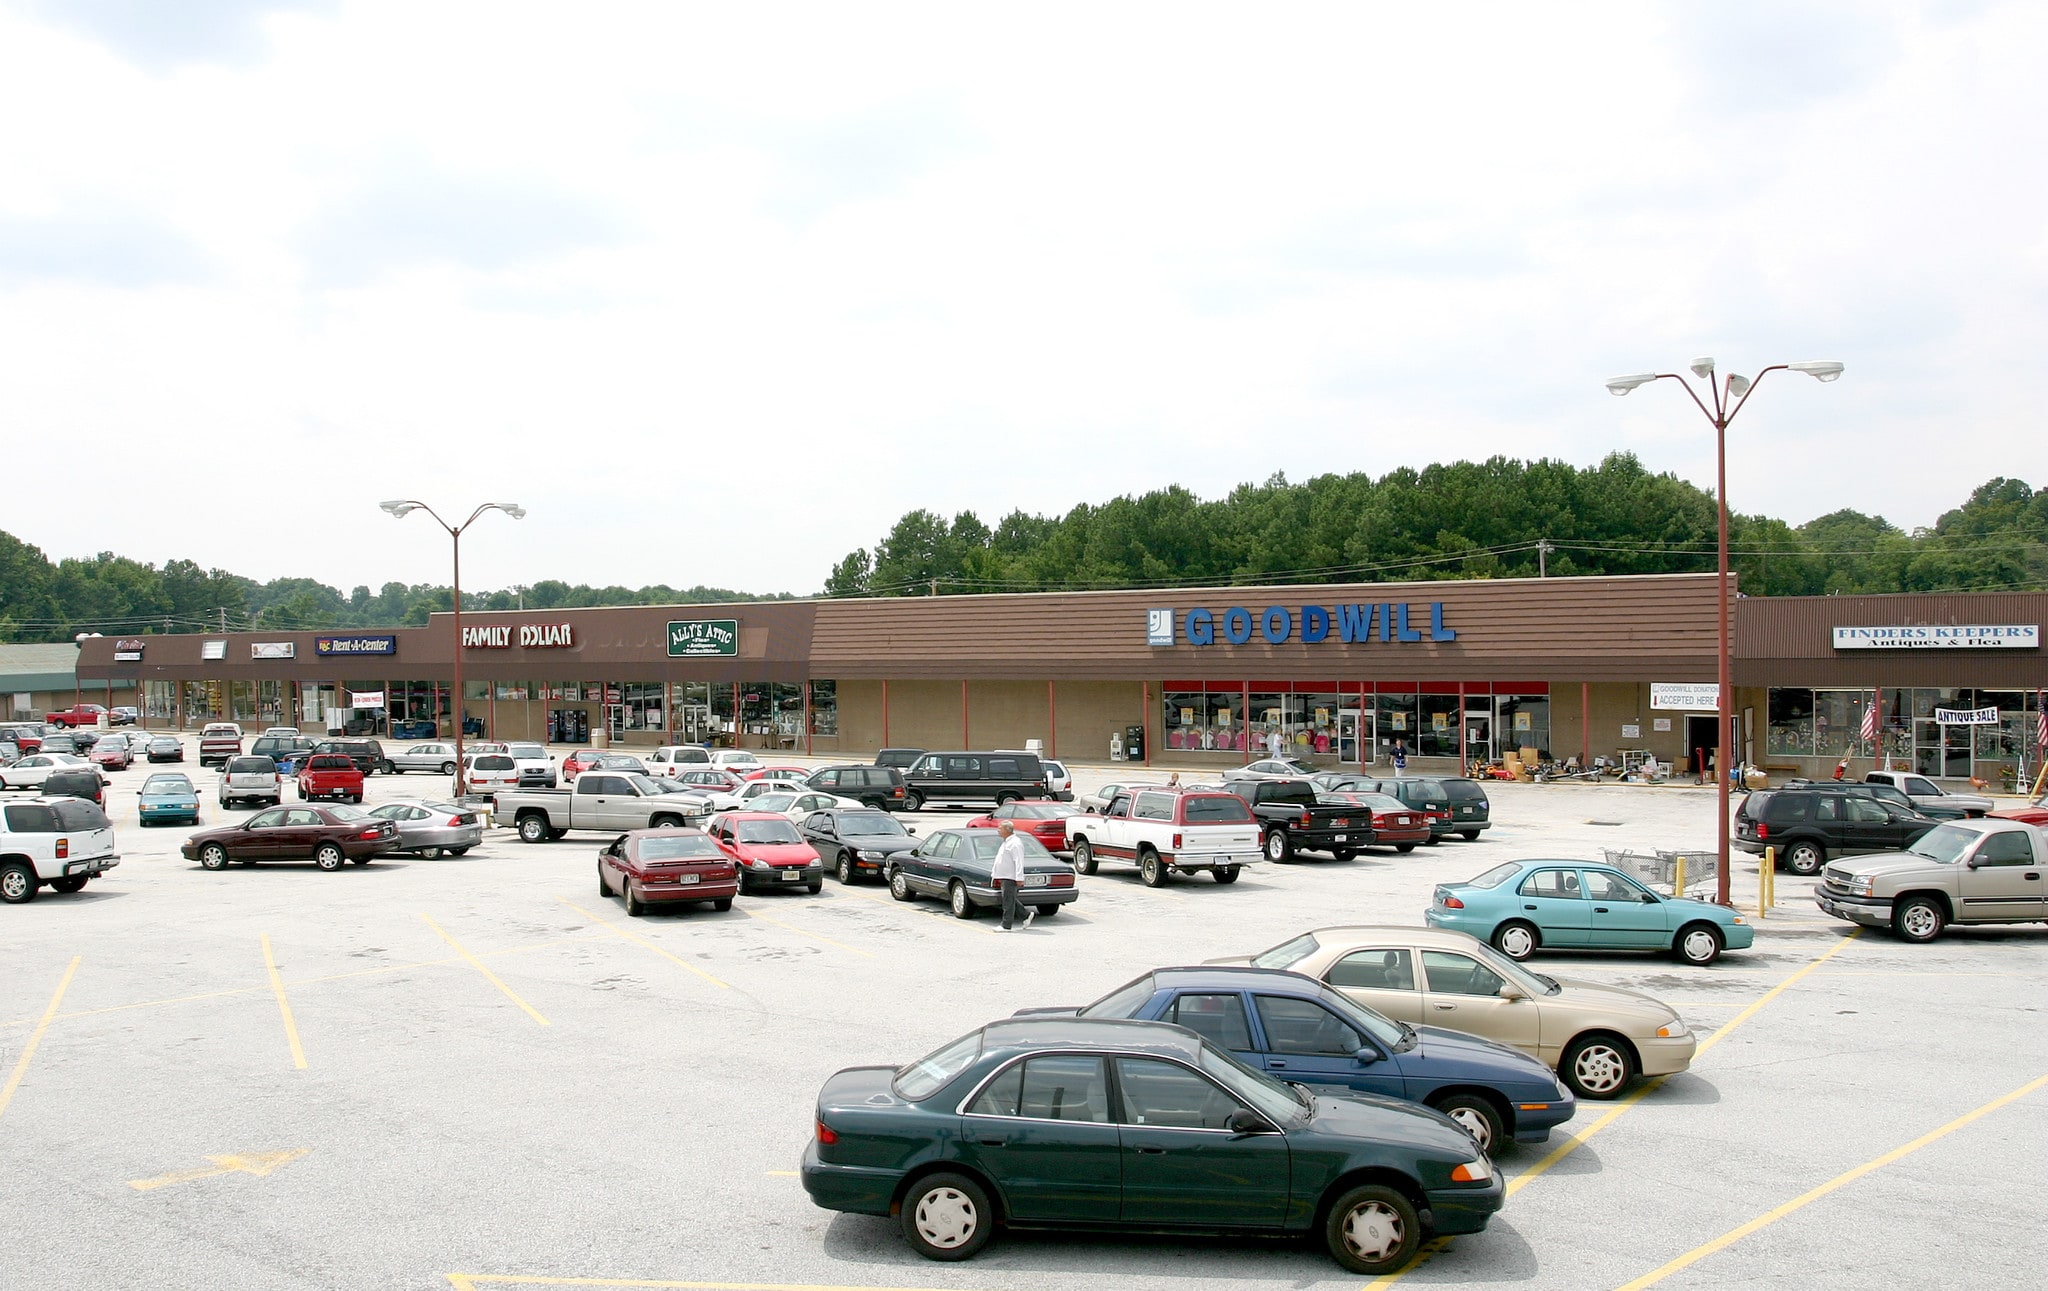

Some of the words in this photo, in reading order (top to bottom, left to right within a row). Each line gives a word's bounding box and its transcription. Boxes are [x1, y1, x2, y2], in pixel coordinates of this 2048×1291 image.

[1184, 602, 1456, 645] GOODWILL
[462, 626, 512, 647] FAMILY
[672, 624, 702, 645] ALLY'S
[706, 624, 733, 644] ATTIC
[1839, 629, 1926, 638] FINDERS
[1936, 627, 2034, 637] KEEPERS
[1868, 639, 1940, 647] Antiques
[1969, 638, 2002, 646] Flea
[1660, 685, 1692, 693] GOODWILL
[1660, 695, 1694, 705] ACCEPTED
[1697, 695, 1715, 706] HERE
[1938, 711, 1974, 723] ANTIQUE
[1977, 709, 1996, 722] SALE
